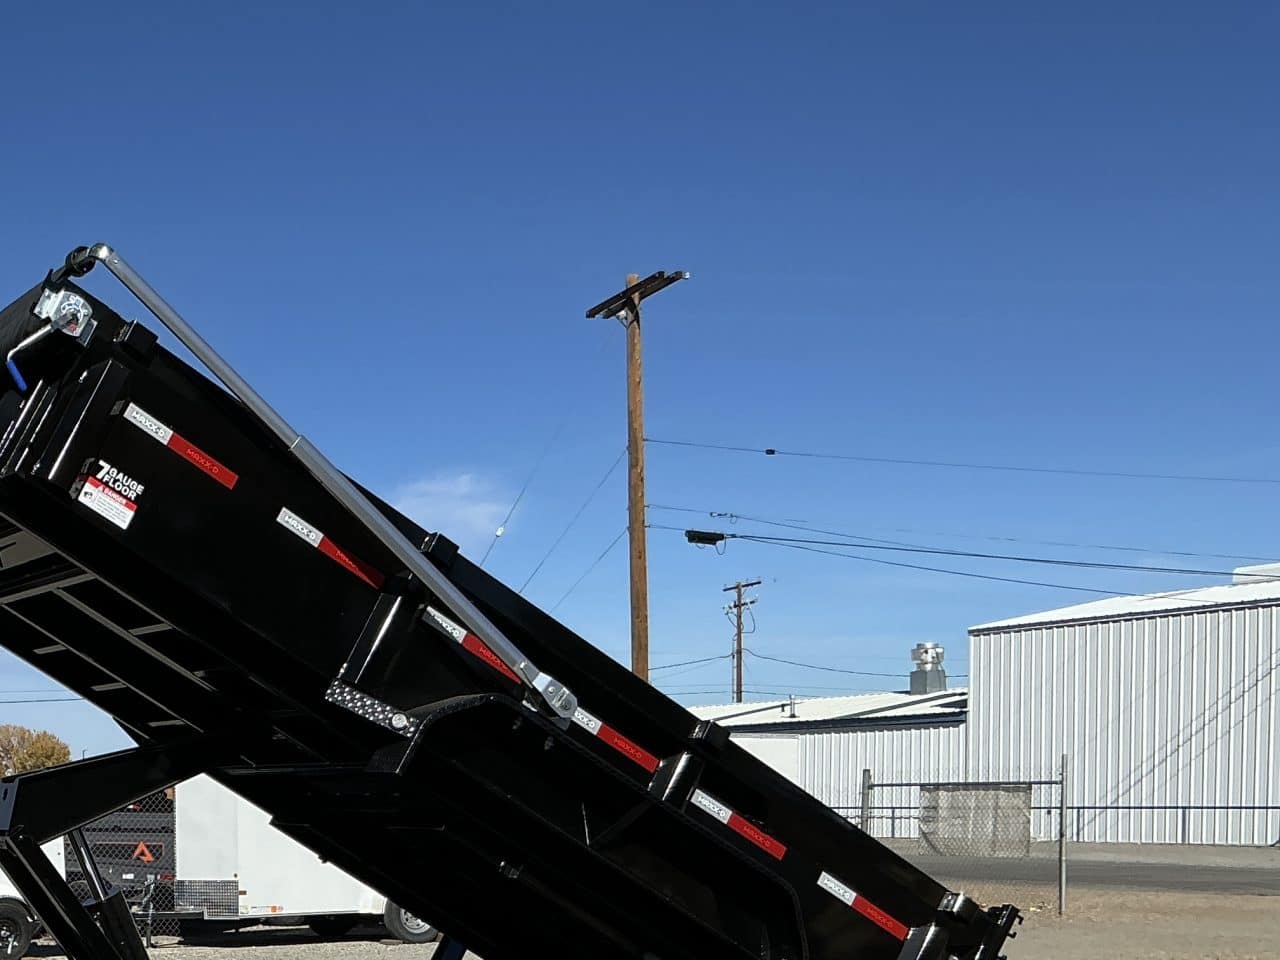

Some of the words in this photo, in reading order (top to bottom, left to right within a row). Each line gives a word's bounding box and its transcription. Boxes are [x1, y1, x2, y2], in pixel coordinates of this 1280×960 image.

[131, 411, 165, 437] MAXX-D
[186, 449, 219, 474] MAXX-D
[96, 459, 111, 479] 7
[109, 467, 145, 495] GAUGE
[103, 474, 137, 501] FLOOR
[284, 515, 316, 540] MAXX-D
